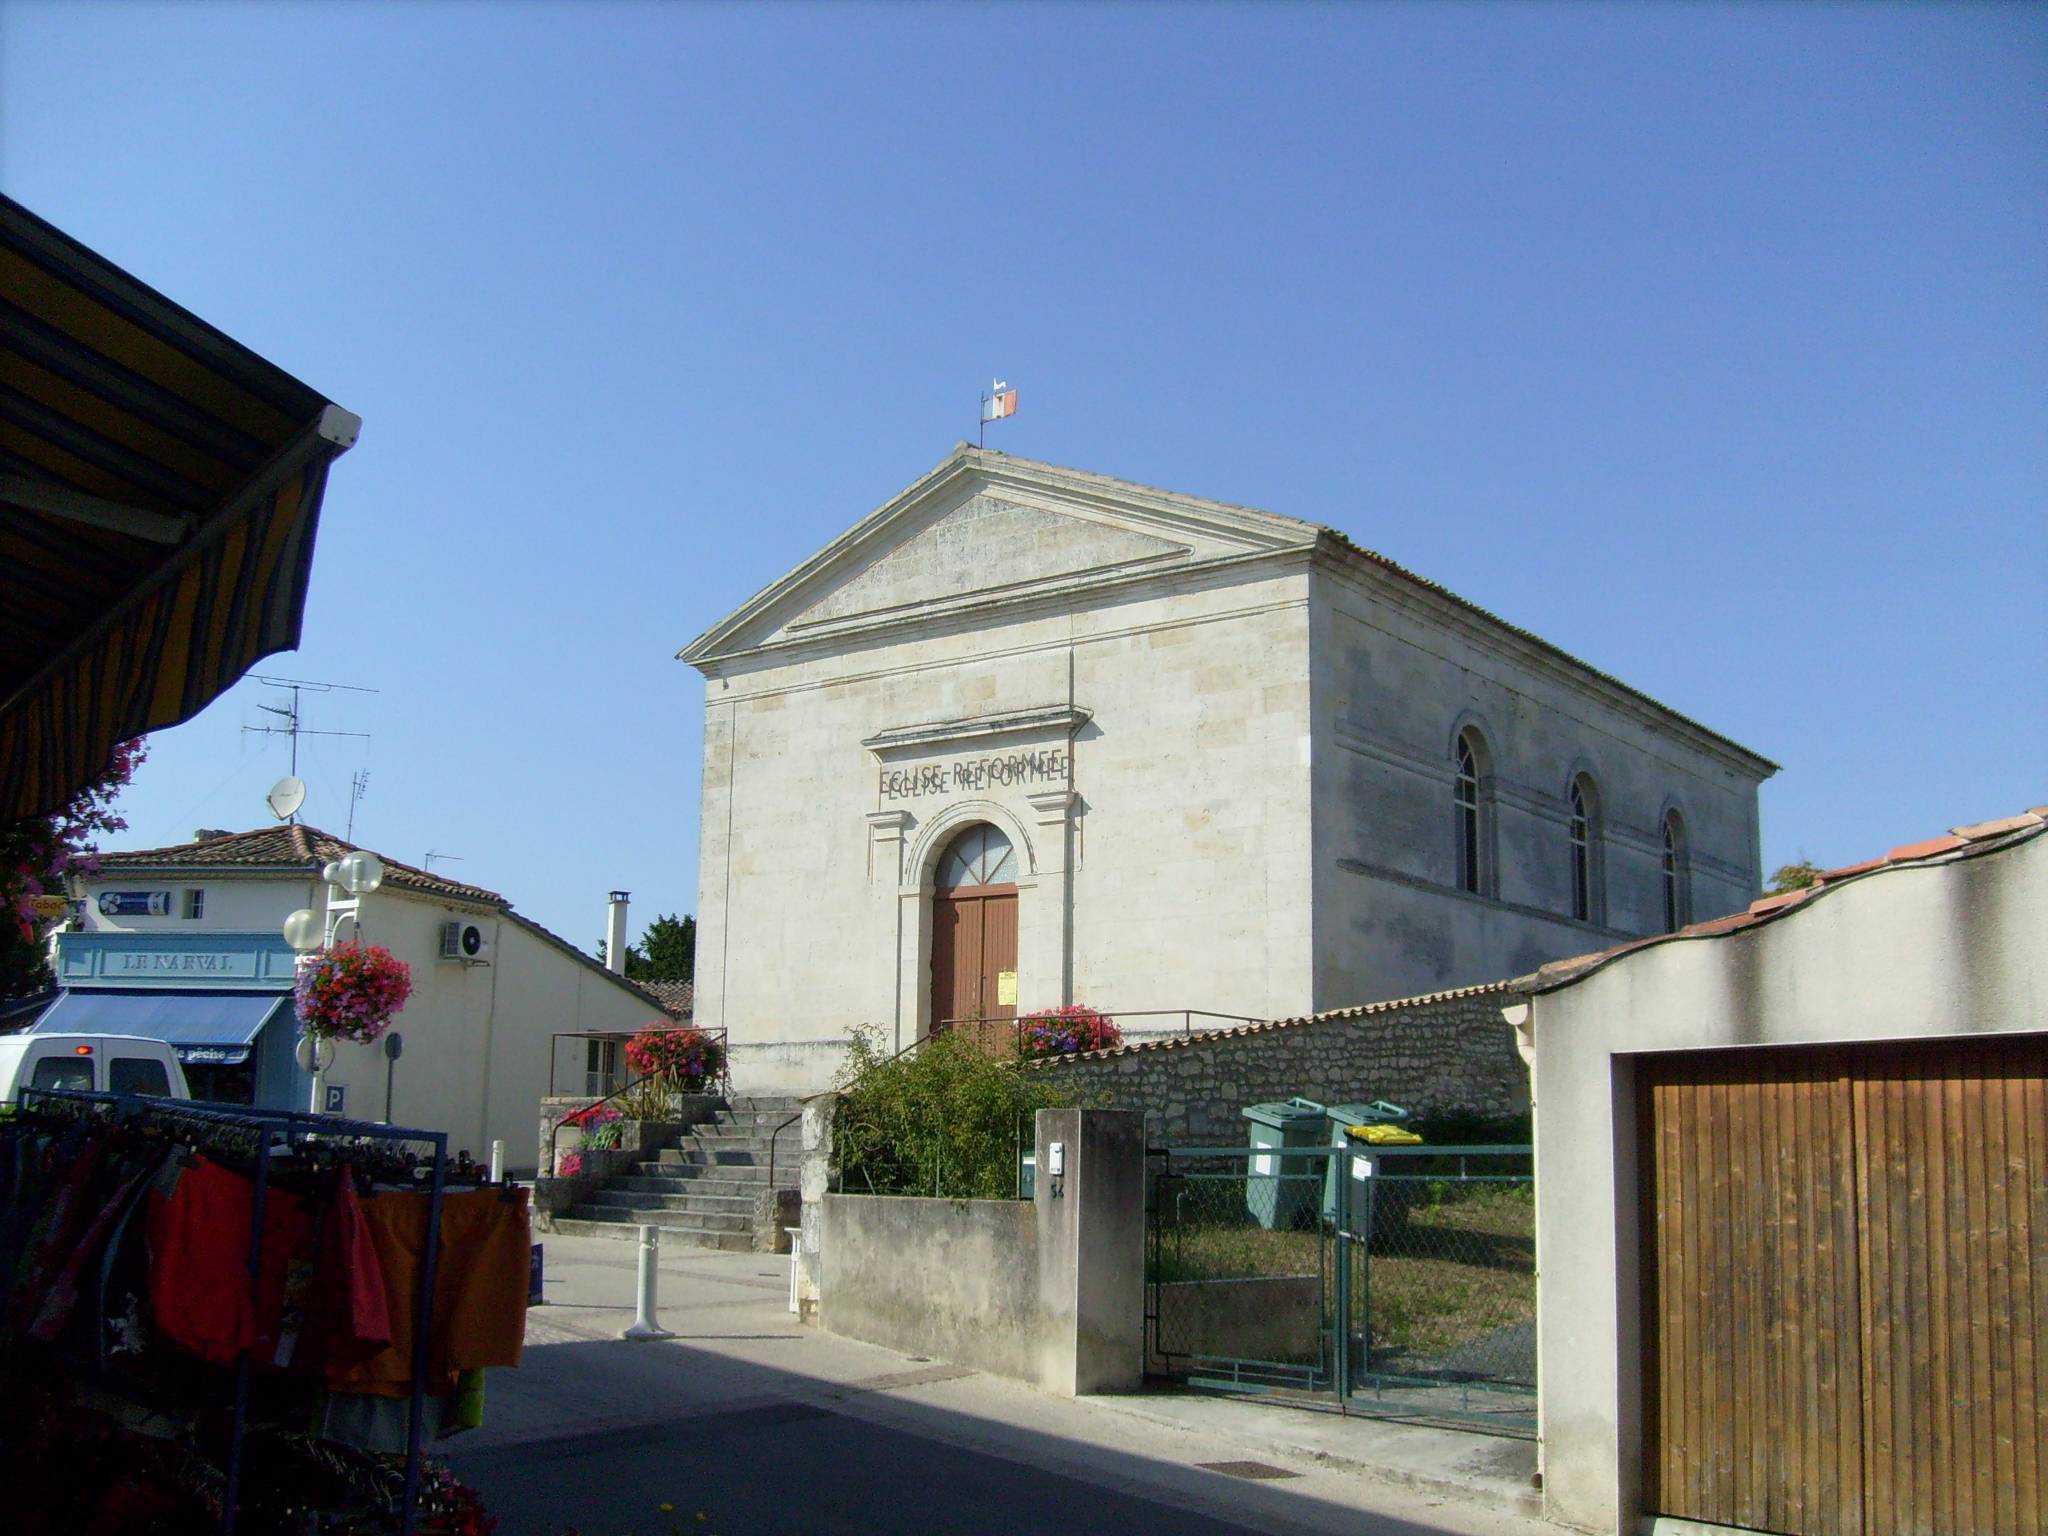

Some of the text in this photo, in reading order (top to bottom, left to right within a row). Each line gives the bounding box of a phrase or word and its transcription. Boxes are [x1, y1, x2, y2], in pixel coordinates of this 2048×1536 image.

[879, 766, 947, 797] EGLISE
[123, 954, 232, 969] LE NARVAL
[329, 1090, 341, 1108] P
